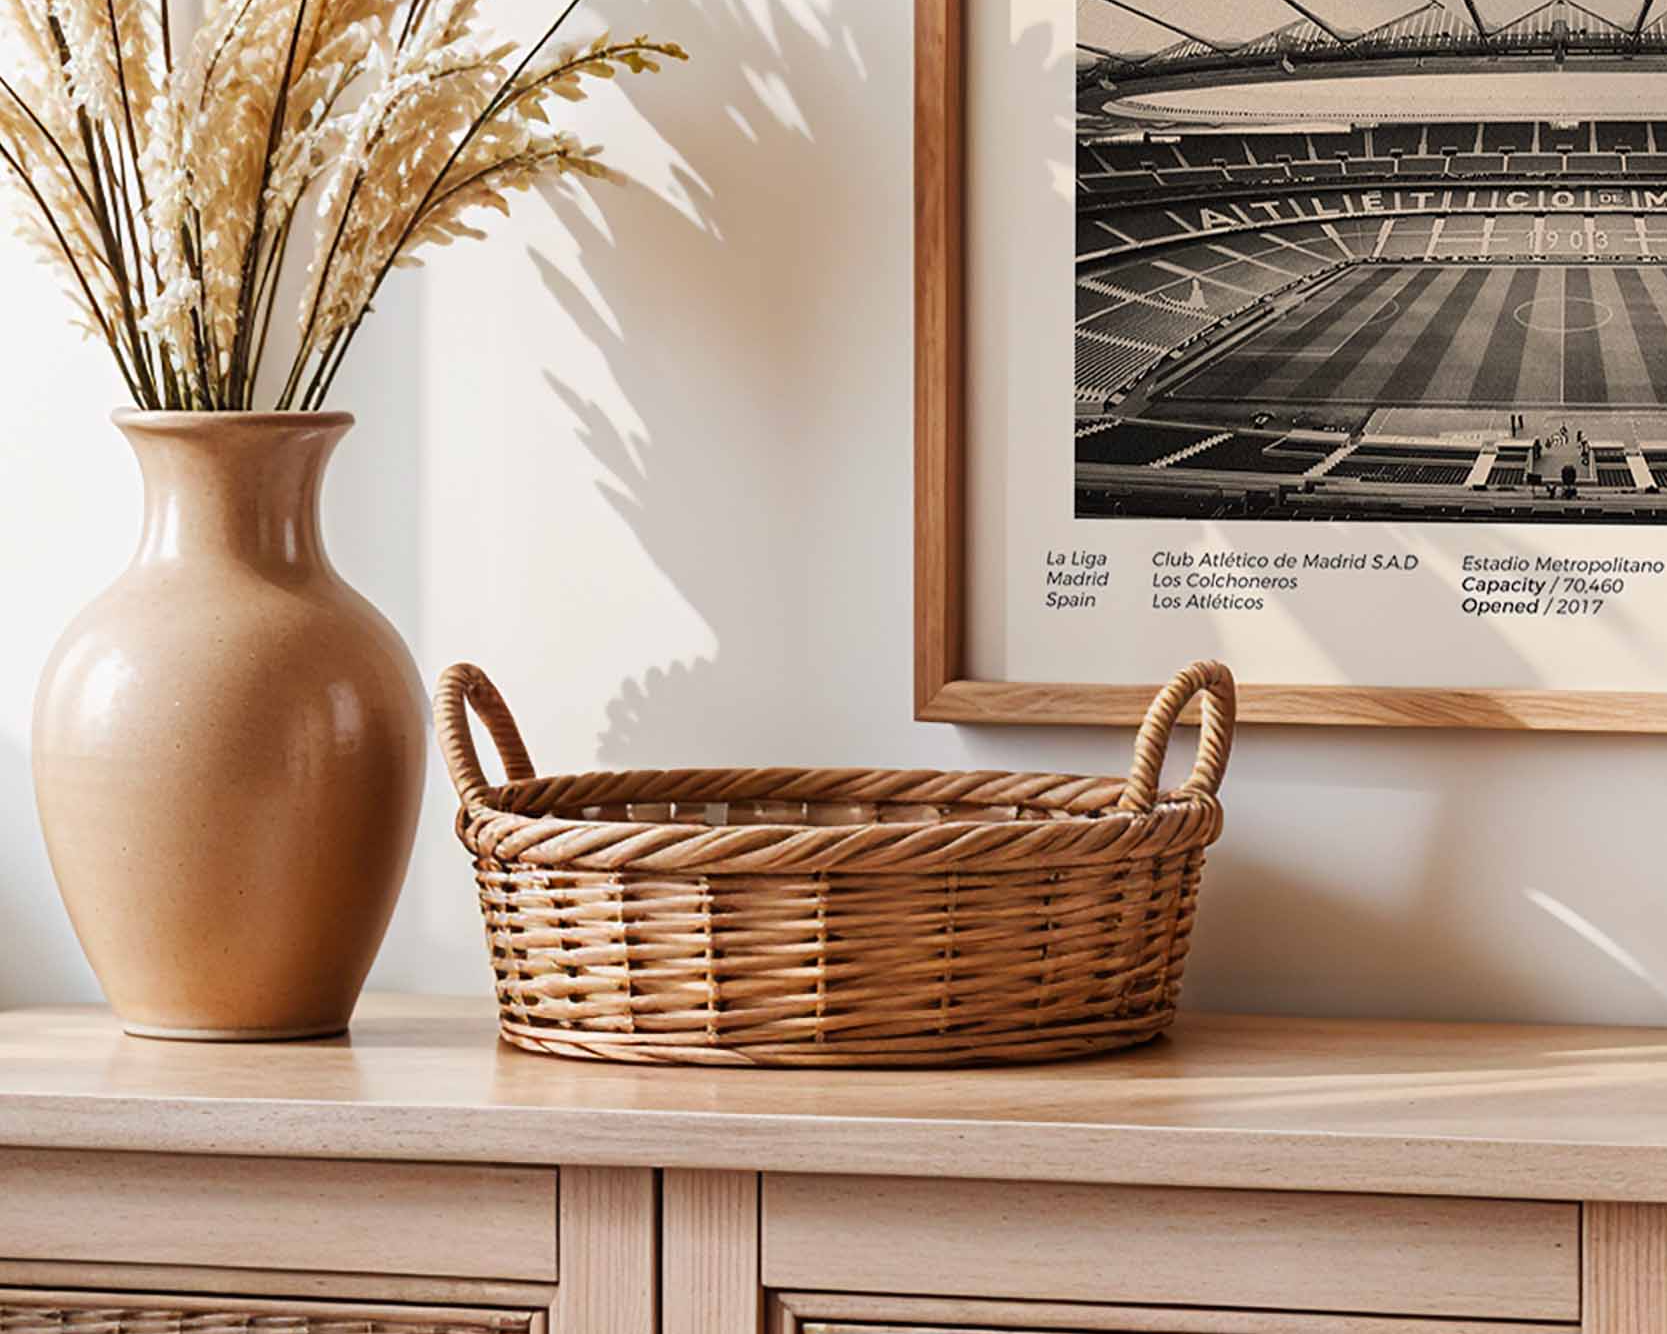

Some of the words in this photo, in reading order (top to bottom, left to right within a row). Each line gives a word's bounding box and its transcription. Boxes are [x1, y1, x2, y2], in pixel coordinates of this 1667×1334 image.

[1525, 232, 1610, 249] 1903
[1046, 550, 1067, 567] La
[1071, 550, 1108, 570] Liga
[1151, 551, 1195, 568] Club
[1198, 551, 1270, 569] Atlético
[1273, 552, 1298, 569] de
[1302, 553, 1368, 571] Madrid
[1461, 554, 1531, 573] Estadio
[1534, 556, 1665, 576] Metropolitano
[1046, 570, 1110, 587] Madrid
[1152, 572, 1182, 589] Los
[1185, 572, 1299, 590] Colchoneros
[1461, 576, 1547, 597] Capacity
[1045, 591, 1096, 611] Spain
[1152, 593, 1182, 610] Los
[1184, 593, 1264, 611] Atléticos
[1461, 597, 1541, 617] Opened
[1555, 598, 1605, 615] 2017
